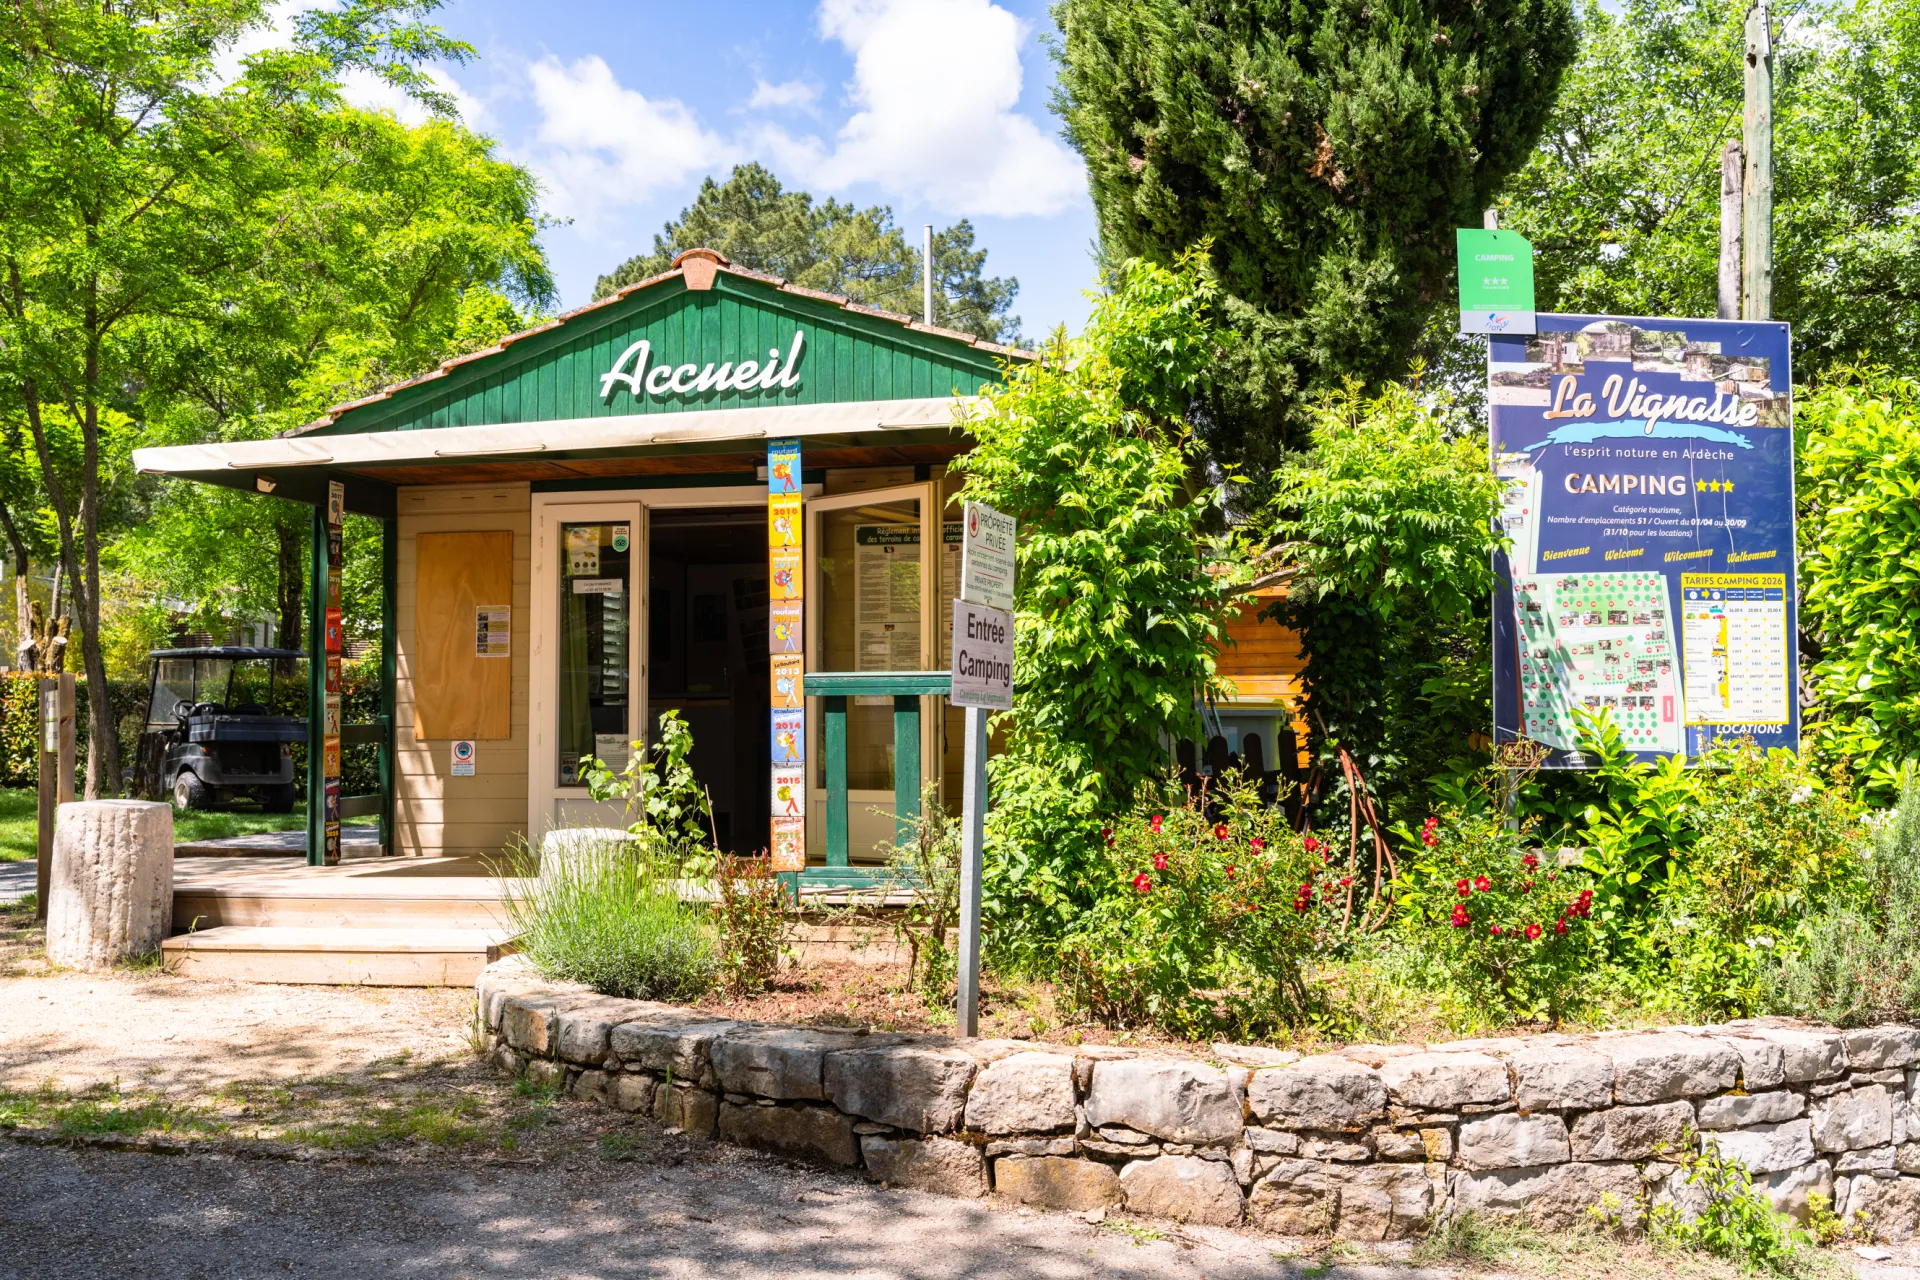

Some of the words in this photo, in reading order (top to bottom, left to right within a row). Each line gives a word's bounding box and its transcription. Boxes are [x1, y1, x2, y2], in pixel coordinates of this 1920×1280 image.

[599, 330, 804, 397] Accueil
[1543, 375, 1597, 420] La
[1602, 374, 1759, 435] Vignasse
[1564, 445, 1611, 458] l'esprit
[1616, 447, 1659, 458] nature
[1662, 449, 1678, 459] en
[1682, 448, 1735, 460] Ardèche
[1564, 472, 1686, 496] CAMPING
[773, 508, 797, 516] 2010
[1613, 505, 1647, 514] Catégorie
[1649, 506, 1682, 515] tourisme,
[980, 513, 1013, 536] PROPRIÉTÉ
[1547, 516, 1576, 524] Nombre
[1578, 516, 1636, 525] d'emplacements
[1691, 518, 1713, 526] 01/04
[1724, 519, 1747, 528] 30/09
[877, 527, 910, 536] Règlement
[1603, 528, 1628, 537] (31/10
[1647, 529, 1657, 537] les
[1658, 529, 1693, 538] locations)
[879, 535, 902, 543] terrains
[985, 532, 1006, 551] PRIVÉE
[1543, 546, 1590, 561] Bienvenue
[1604, 547, 1644, 561] Welcome
[1664, 548, 1713, 562] Wilcommen
[1727, 550, 1777, 563] Walkommen
[775, 561, 798, 569] 2011
[974, 575, 987, 585] PRIVATE
[987, 578, 1004, 590] PROPERTY
[1684, 576, 1714, 585] TARIFS
[1717, 576, 1759, 585] CAMPING
[1761, 576, 1783, 585] 2026
[967, 612, 1005, 644] Entrée
[775, 668, 800, 676] 2013
[958, 649, 1010, 688] Camping
[960, 689, 980, 702] Camping
[775, 722, 801, 730] 2014
[1716, 724, 1783, 734] LOCATIONS
